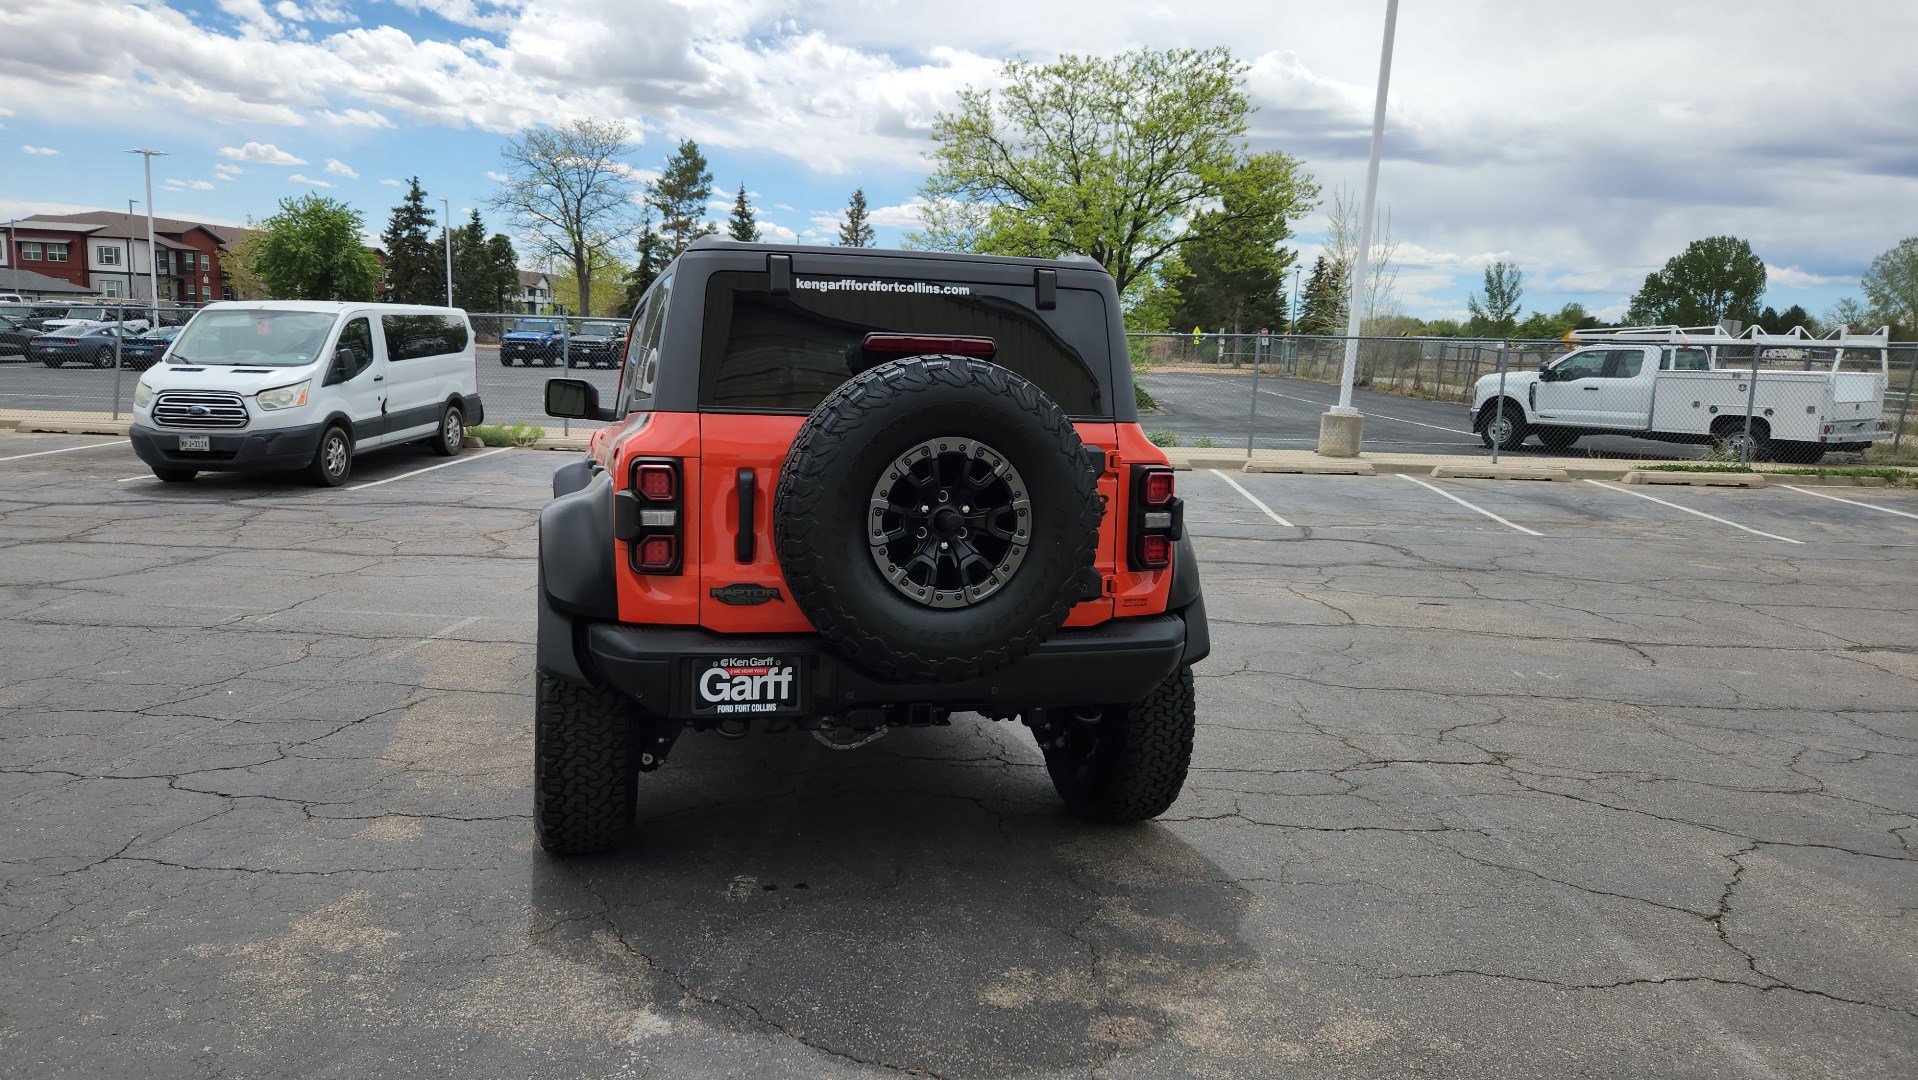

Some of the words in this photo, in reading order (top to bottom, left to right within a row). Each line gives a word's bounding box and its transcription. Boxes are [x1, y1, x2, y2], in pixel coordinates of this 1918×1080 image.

[796, 278, 970, 295] kengarfffordfortcollins.com
[710, 587, 784, 603] RAPTOR
[730, 658, 749, 667] Ken
[750, 657, 774, 667] Garff
[699, 666, 793, 702] Garff
[717, 704, 734, 713] FORD
[735, 704, 750, 713] FORT
[751, 703, 777, 712] COLLINS
